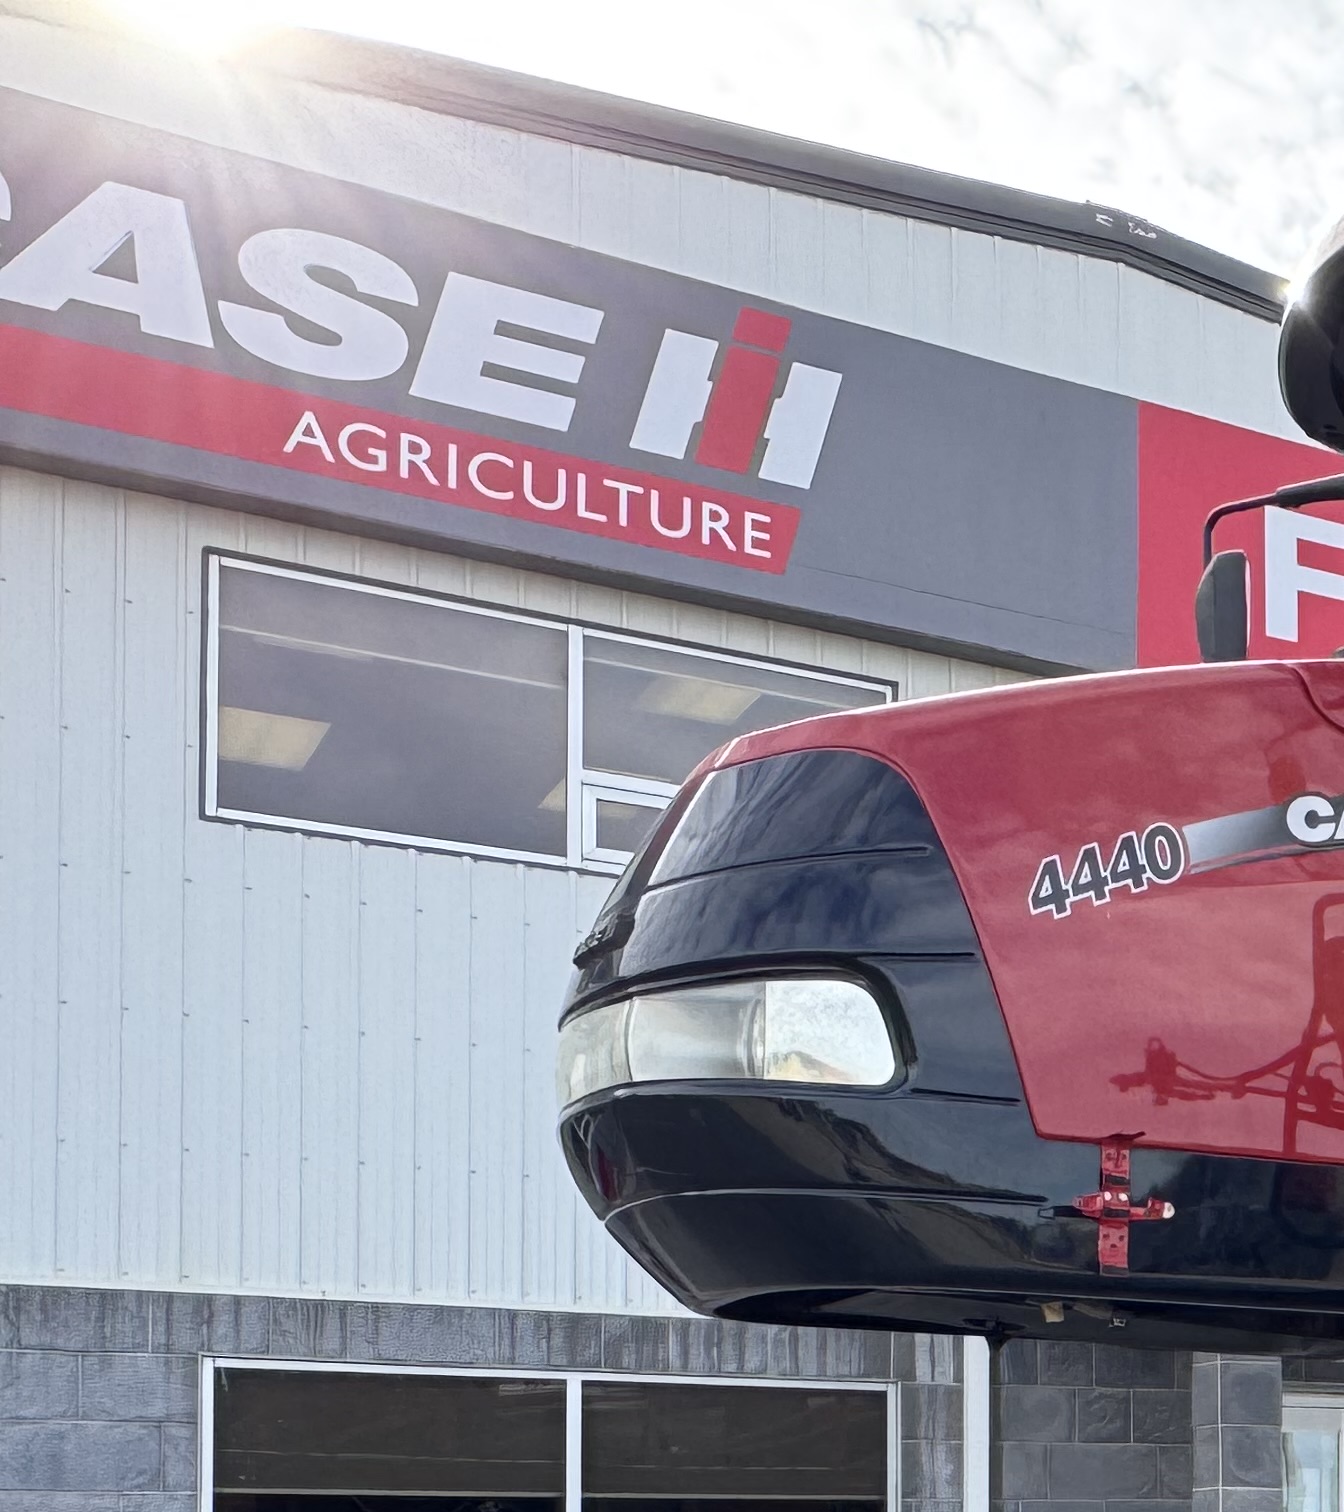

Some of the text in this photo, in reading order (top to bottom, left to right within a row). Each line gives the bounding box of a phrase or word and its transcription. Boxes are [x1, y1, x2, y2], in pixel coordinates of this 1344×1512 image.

[0, 171, 605, 432] ASE
[283, 411, 772, 559] AGRICULTURE
[1028, 822, 1185, 919] 4440
